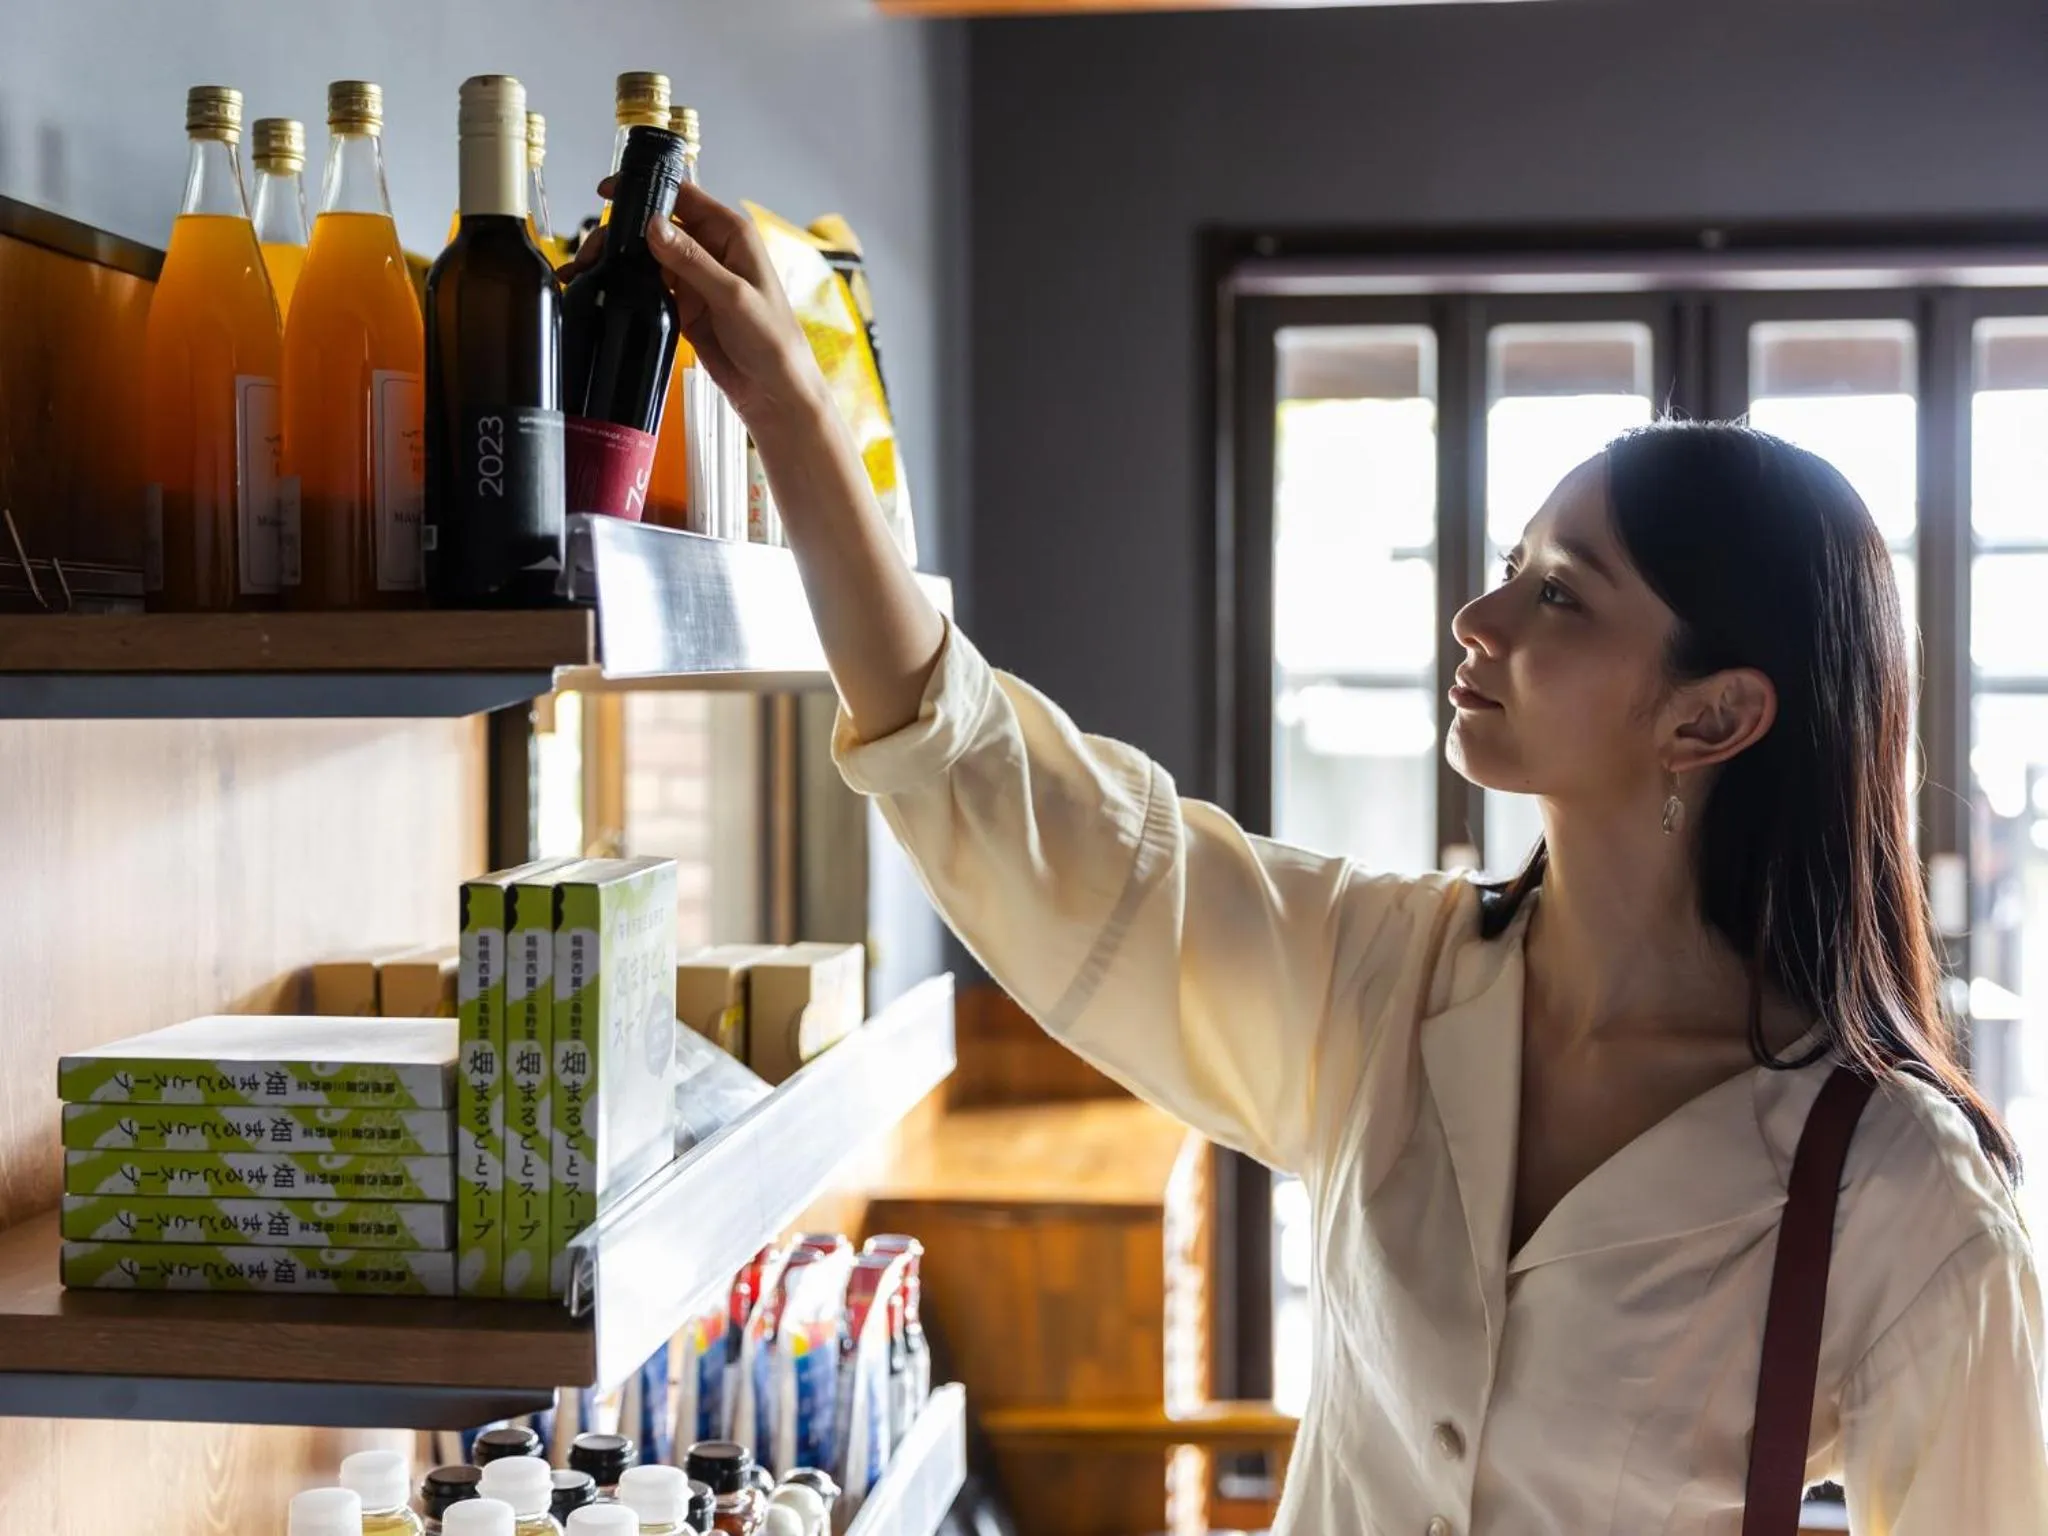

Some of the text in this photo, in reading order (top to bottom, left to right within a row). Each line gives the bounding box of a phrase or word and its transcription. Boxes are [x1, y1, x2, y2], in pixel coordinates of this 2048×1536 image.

[478, 416, 503, 496] 2023
[114, 1070, 288, 1096] 畑まるごとスープ
[118, 1118, 293, 1143] 畑まるごとスープ
[469, 1051, 494, 1241] 畑まるごとスープ
[516, 1051, 541, 1241] 畑まるごとスープ
[120, 1163, 295, 1188] 畑まるごとスープ
[116, 1211, 290, 1236] 畑まるごとスープ
[118, 1257, 296, 1284] 畑まるごとスープ
